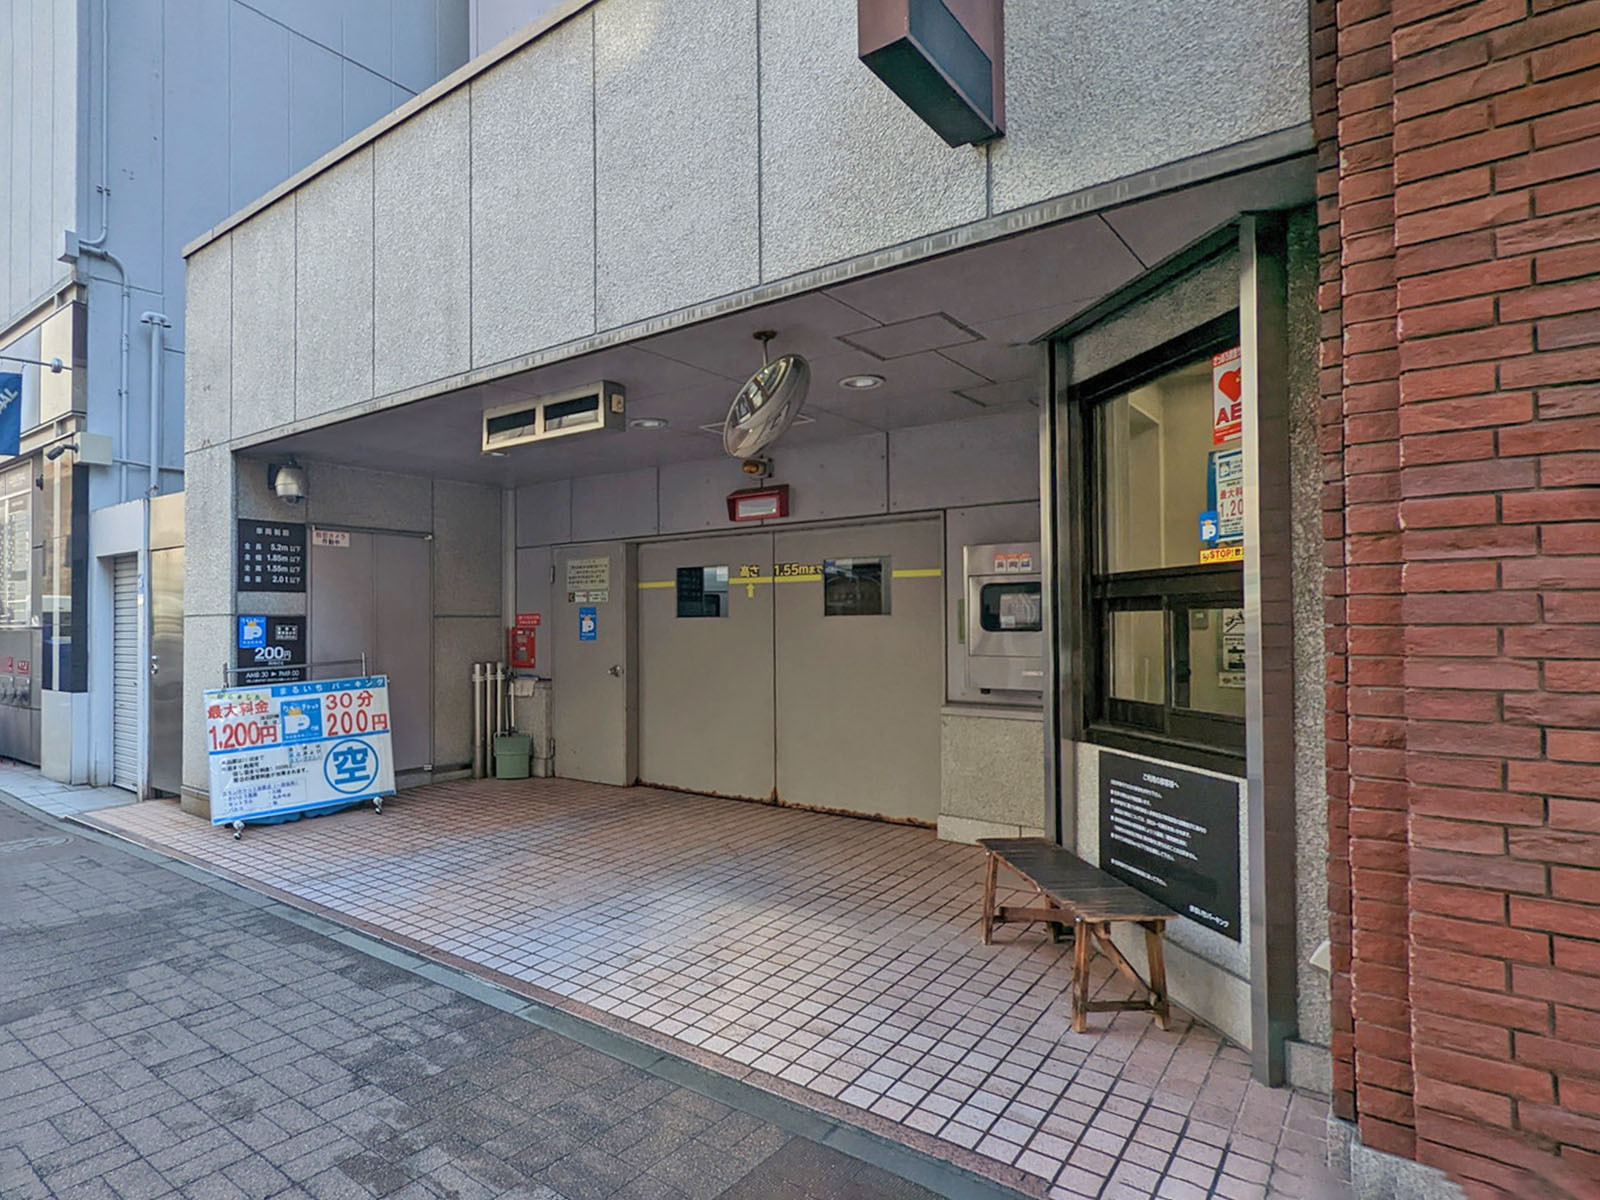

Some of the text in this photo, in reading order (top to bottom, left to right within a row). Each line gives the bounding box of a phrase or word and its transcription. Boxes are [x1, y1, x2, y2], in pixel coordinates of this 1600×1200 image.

[740, 564, 760, 578] 高さ
[331, 678, 384, 690] パーキング
[208, 700, 269, 719] 最大料金
[326, 690, 373, 711] 30分
[327, 709, 388, 737] 200円
[333, 747, 371, 785] 空
